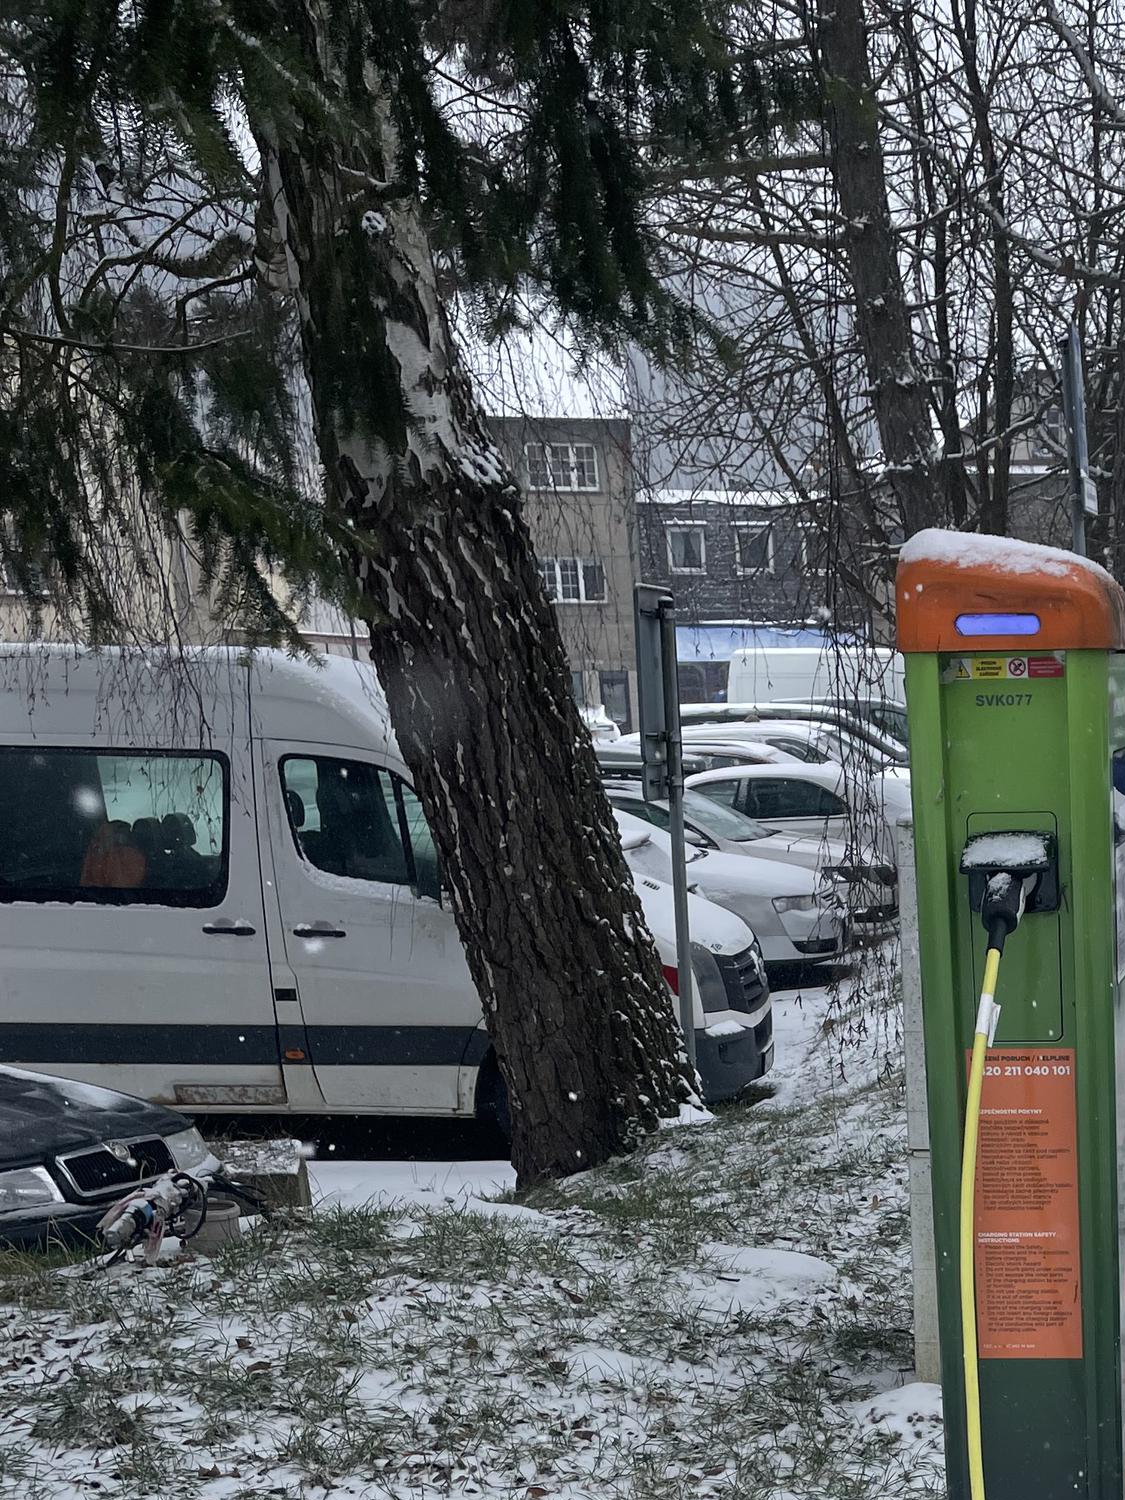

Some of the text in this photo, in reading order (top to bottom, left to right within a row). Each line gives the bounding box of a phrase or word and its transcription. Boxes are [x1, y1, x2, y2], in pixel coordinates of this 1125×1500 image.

[975, 694, 1033, 707] SVK077
[983, 1066, 1070, 1076] 20 211 040 101
